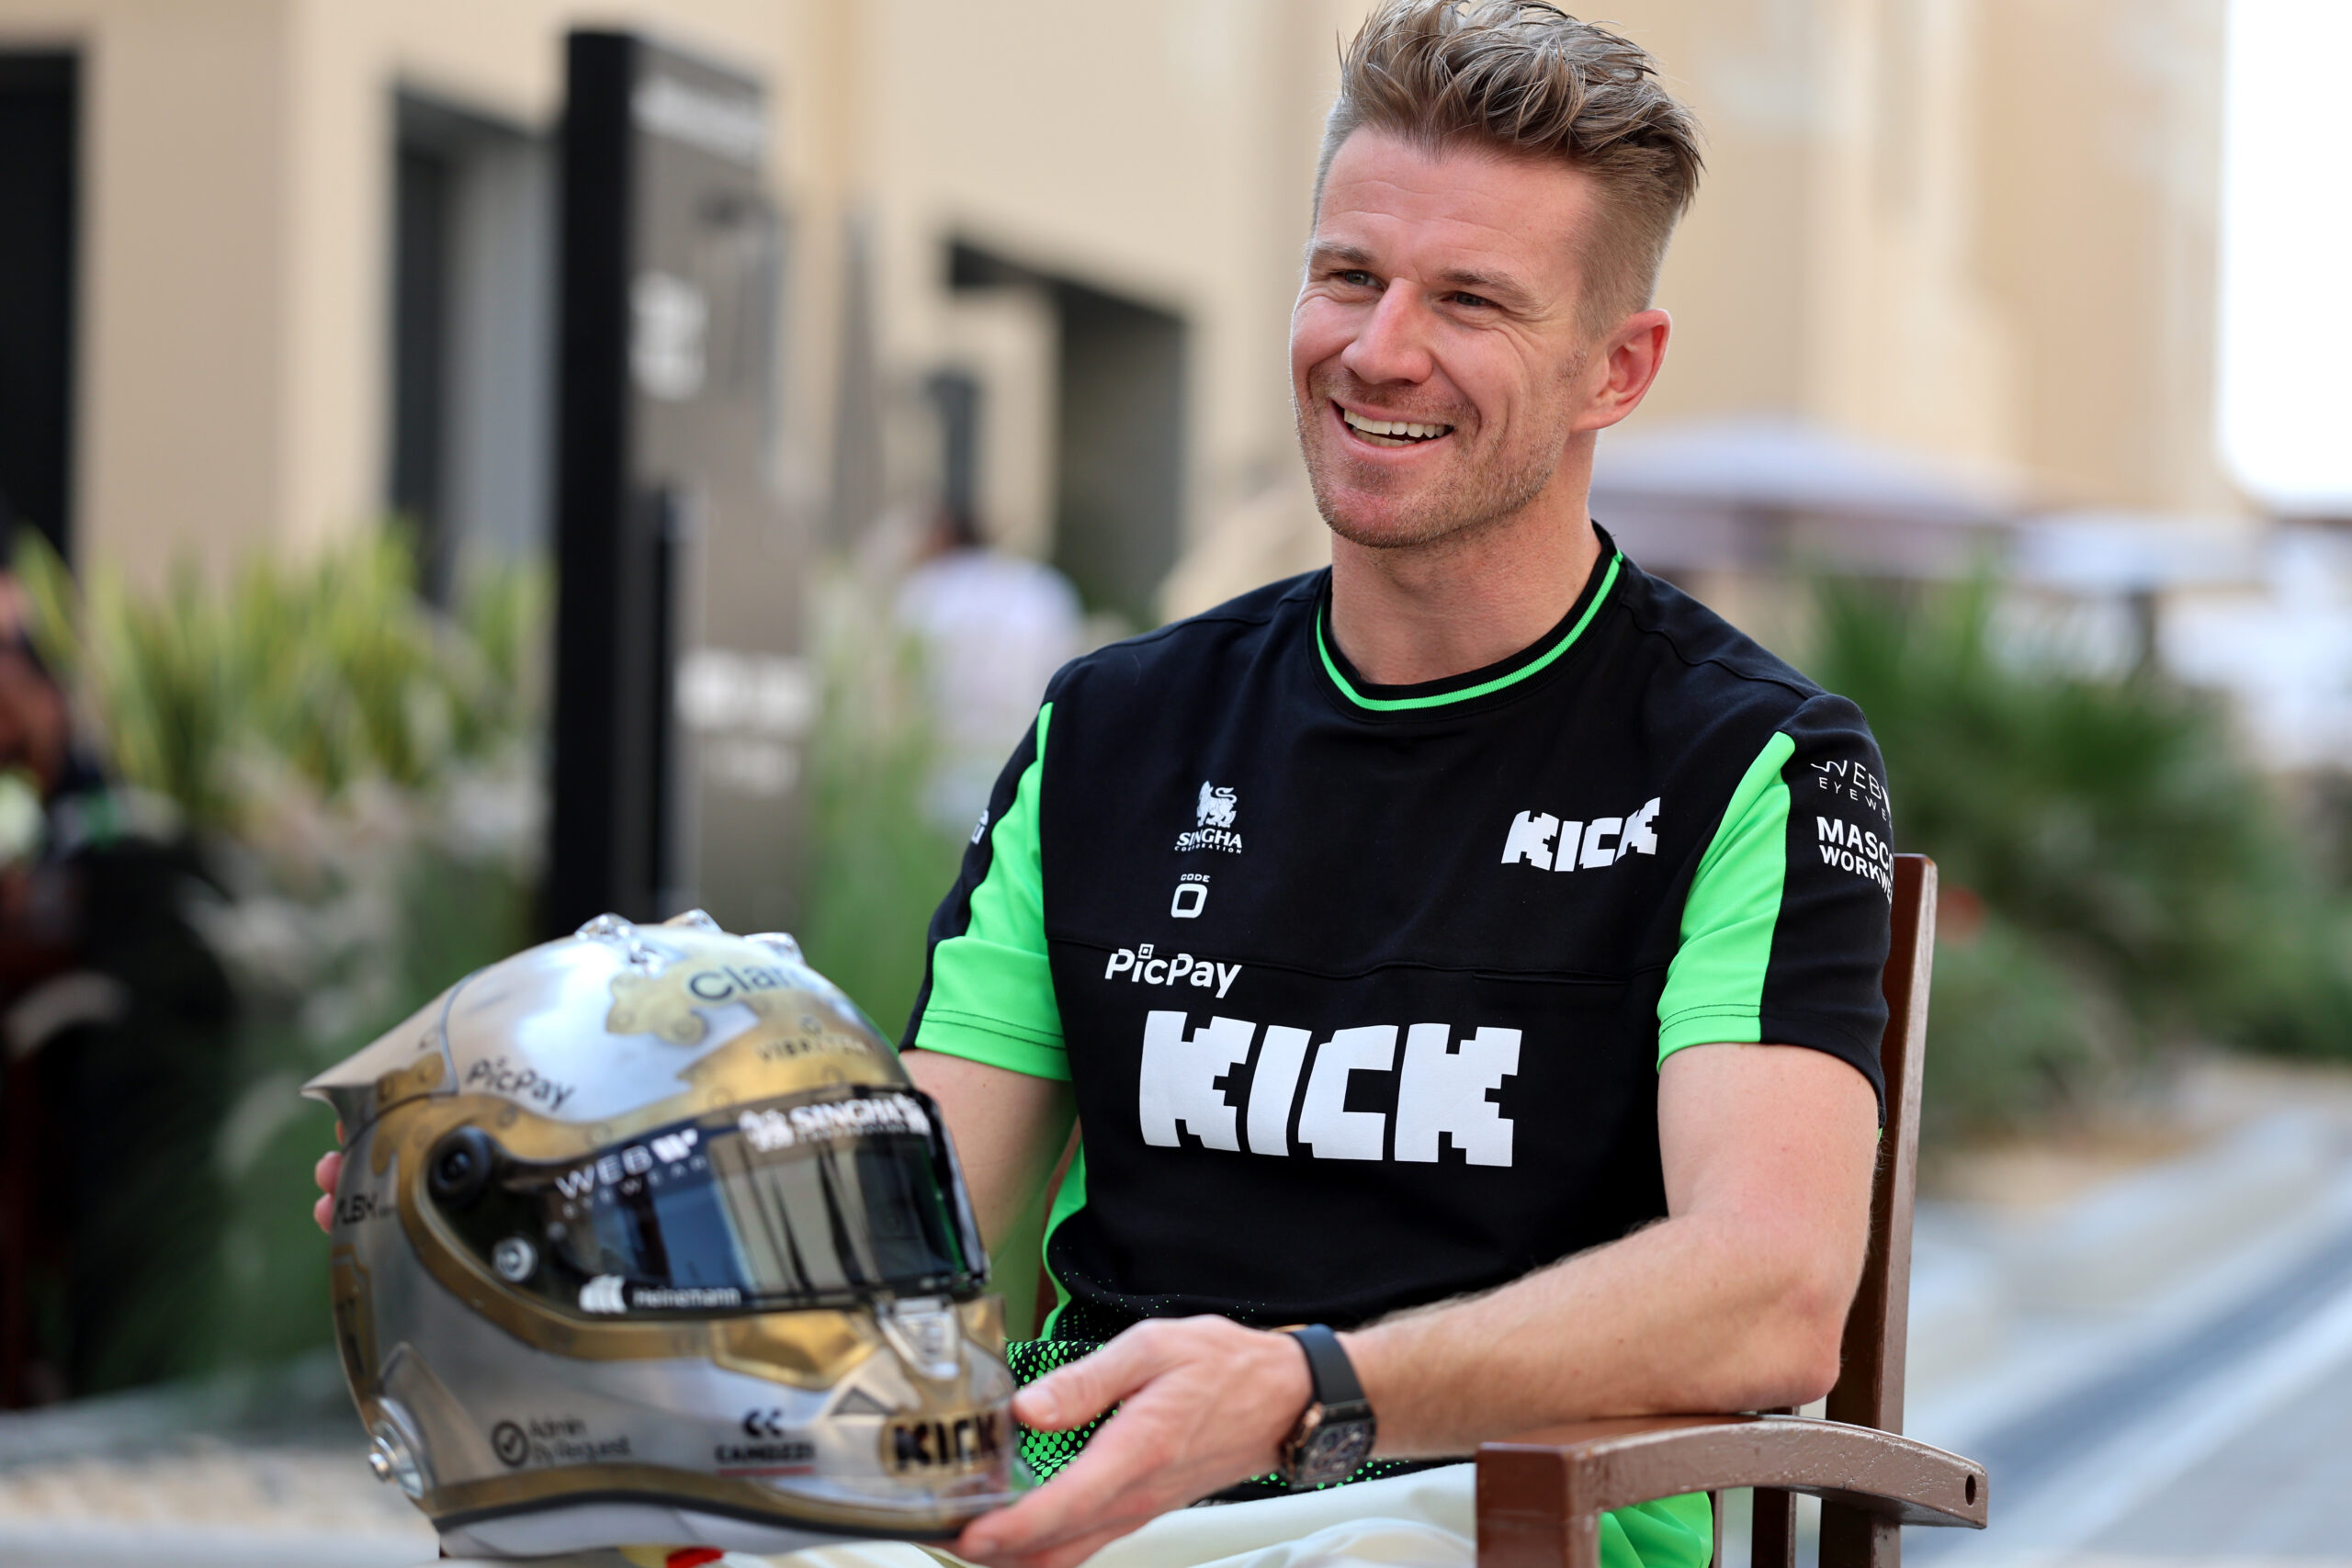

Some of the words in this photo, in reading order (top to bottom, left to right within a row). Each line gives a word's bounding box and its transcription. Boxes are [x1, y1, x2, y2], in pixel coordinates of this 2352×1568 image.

[1819, 777, 1891, 829] EYEWE
[1176, 829, 1242, 848] SINGHA
[1501, 797, 1660, 872] KICK
[1816, 817, 1894, 880] MASCO
[1181, 874, 1210, 883] CODE
[1818, 845, 1893, 906] WORKWE
[690, 966, 801, 1000] Clar
[1104, 942, 1242, 998] PicPay
[465, 1056, 576, 1111] PicPay
[1139, 1010, 1522, 1167] KICK
[894, 1412, 999, 1472] KICK
